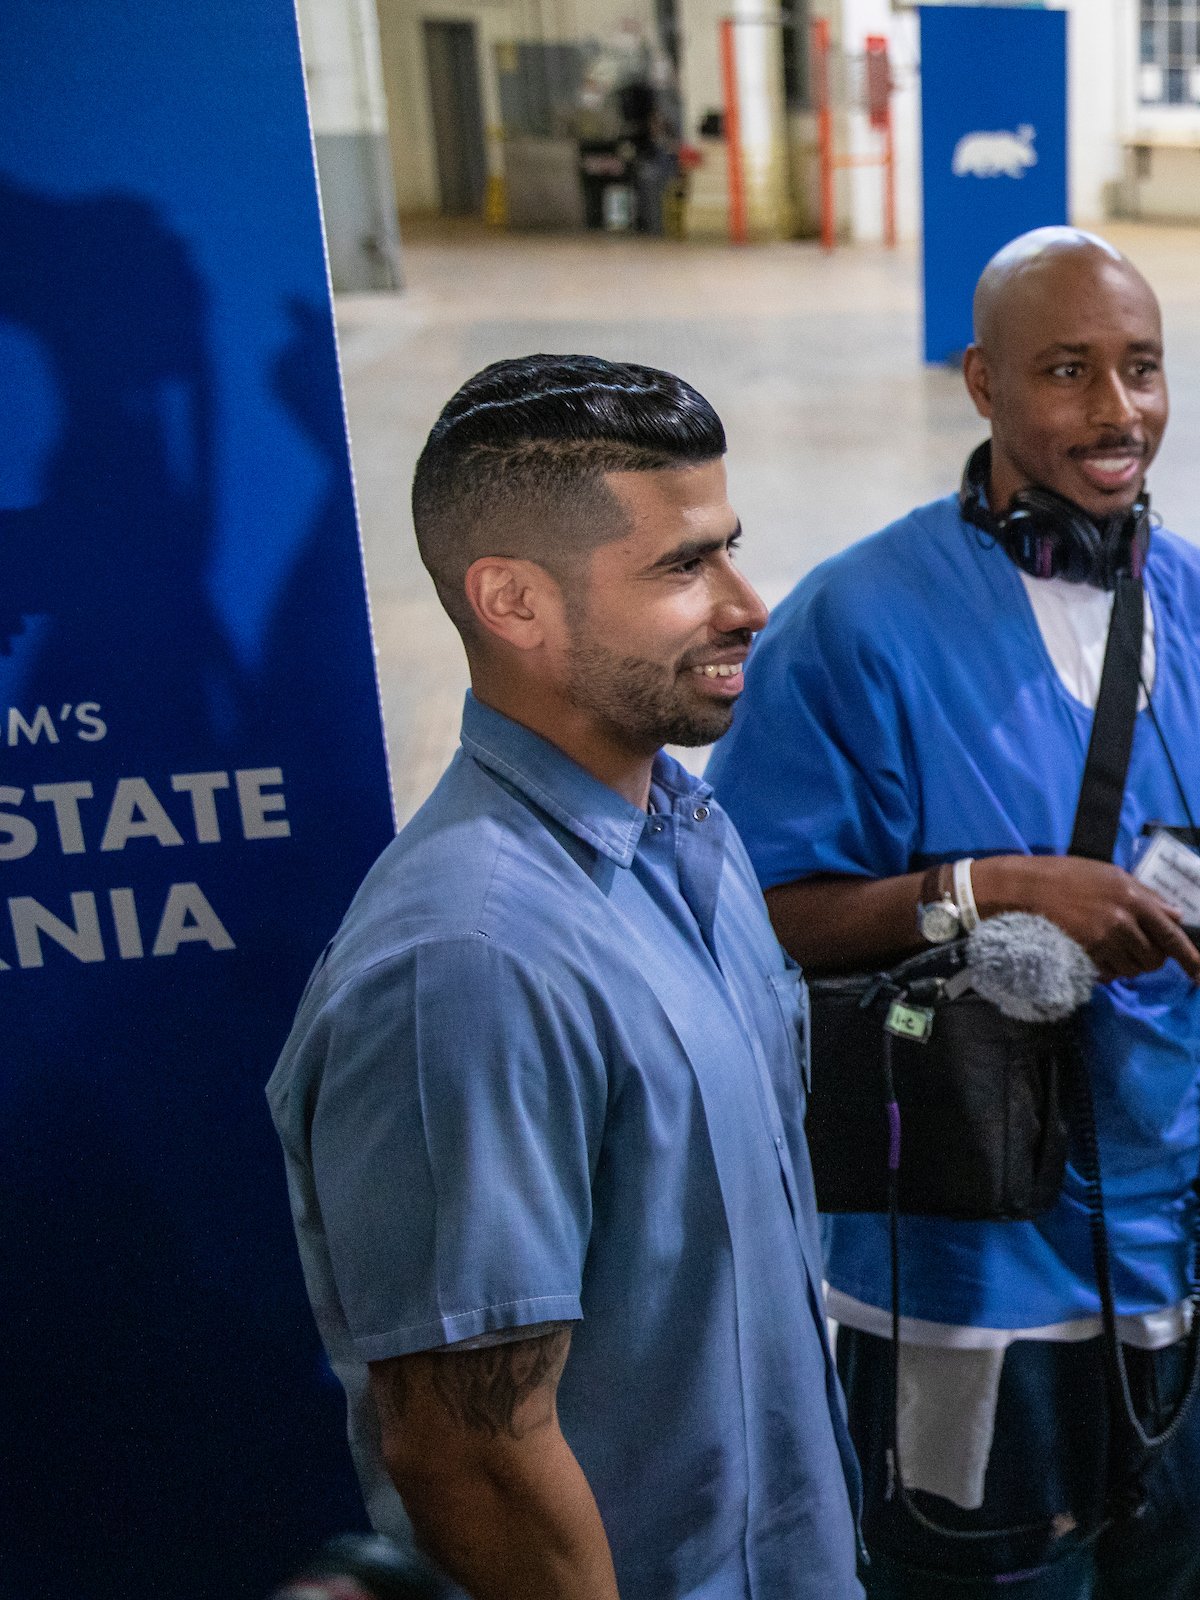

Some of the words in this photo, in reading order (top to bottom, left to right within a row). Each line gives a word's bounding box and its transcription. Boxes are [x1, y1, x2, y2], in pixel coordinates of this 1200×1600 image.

[0, 702, 107, 747] M'S
[0, 767, 291, 861] STATE
[0, 882, 236, 970] NIA
